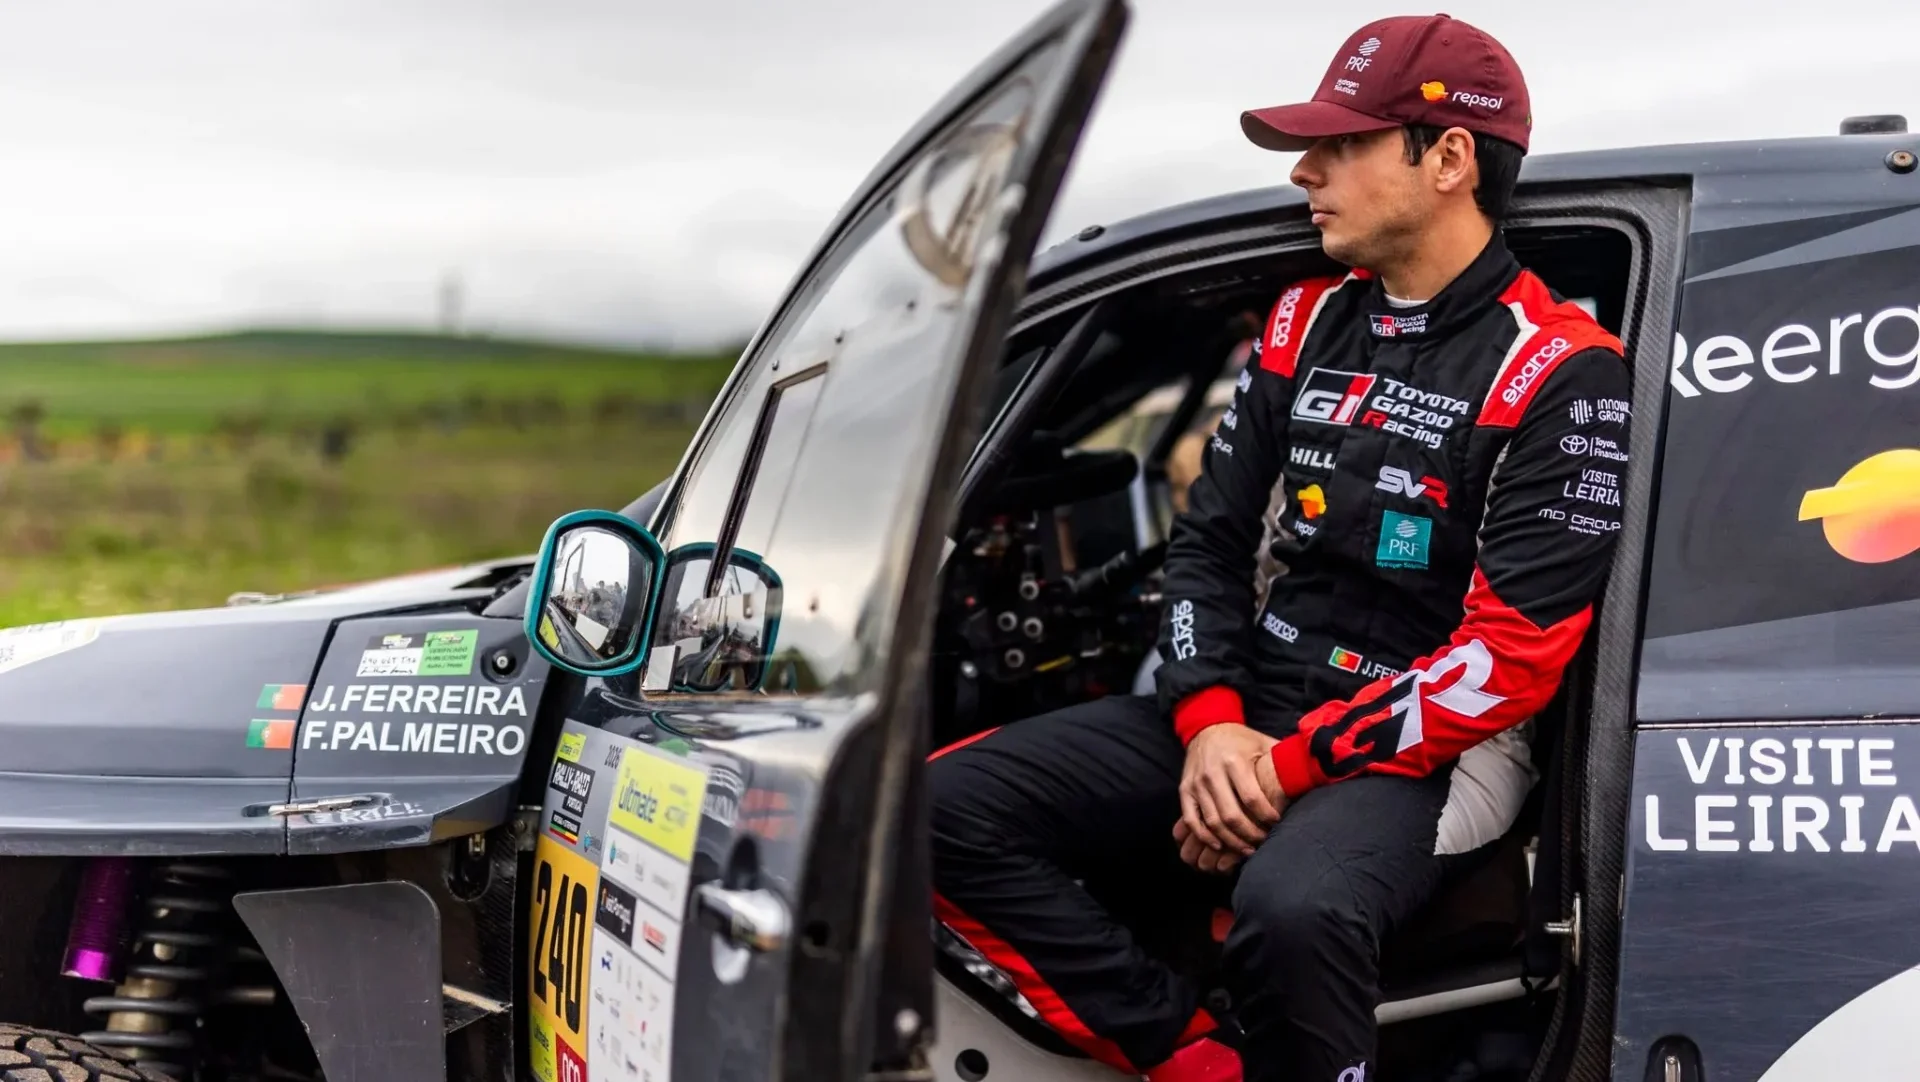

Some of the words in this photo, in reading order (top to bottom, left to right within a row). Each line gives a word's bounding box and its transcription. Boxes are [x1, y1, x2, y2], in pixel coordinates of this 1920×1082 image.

[1344, 56, 1373, 72] PRF
[1452, 91, 1503, 109] repsol
[1502, 337, 1572, 407] sparco
[1371, 395, 1454, 429] GAZOO
[1384, 378, 1470, 415] TOYOTA
[1361, 410, 1443, 450] Racing
[1598, 410, 1625, 423] GROUP
[1595, 436, 1617, 449] Toyota
[1375, 465, 1448, 508] SVR
[1563, 481, 1621, 507] LEIRIA
[1582, 468, 1618, 487] VISITE
[1538, 508, 1566, 521] MD
[1571, 514, 1621, 531] GROUP
[1389, 538, 1420, 557] PRF
[1361, 660, 1405, 680] J.FER
[311, 684, 528, 717] J.FERREIRA
[302, 720, 526, 756] F.PALMEIRO
[1677, 738, 1897, 785] VISITE
[1646, 795, 1920, 852] LEIRIA
[534, 860, 587, 1034] 240
